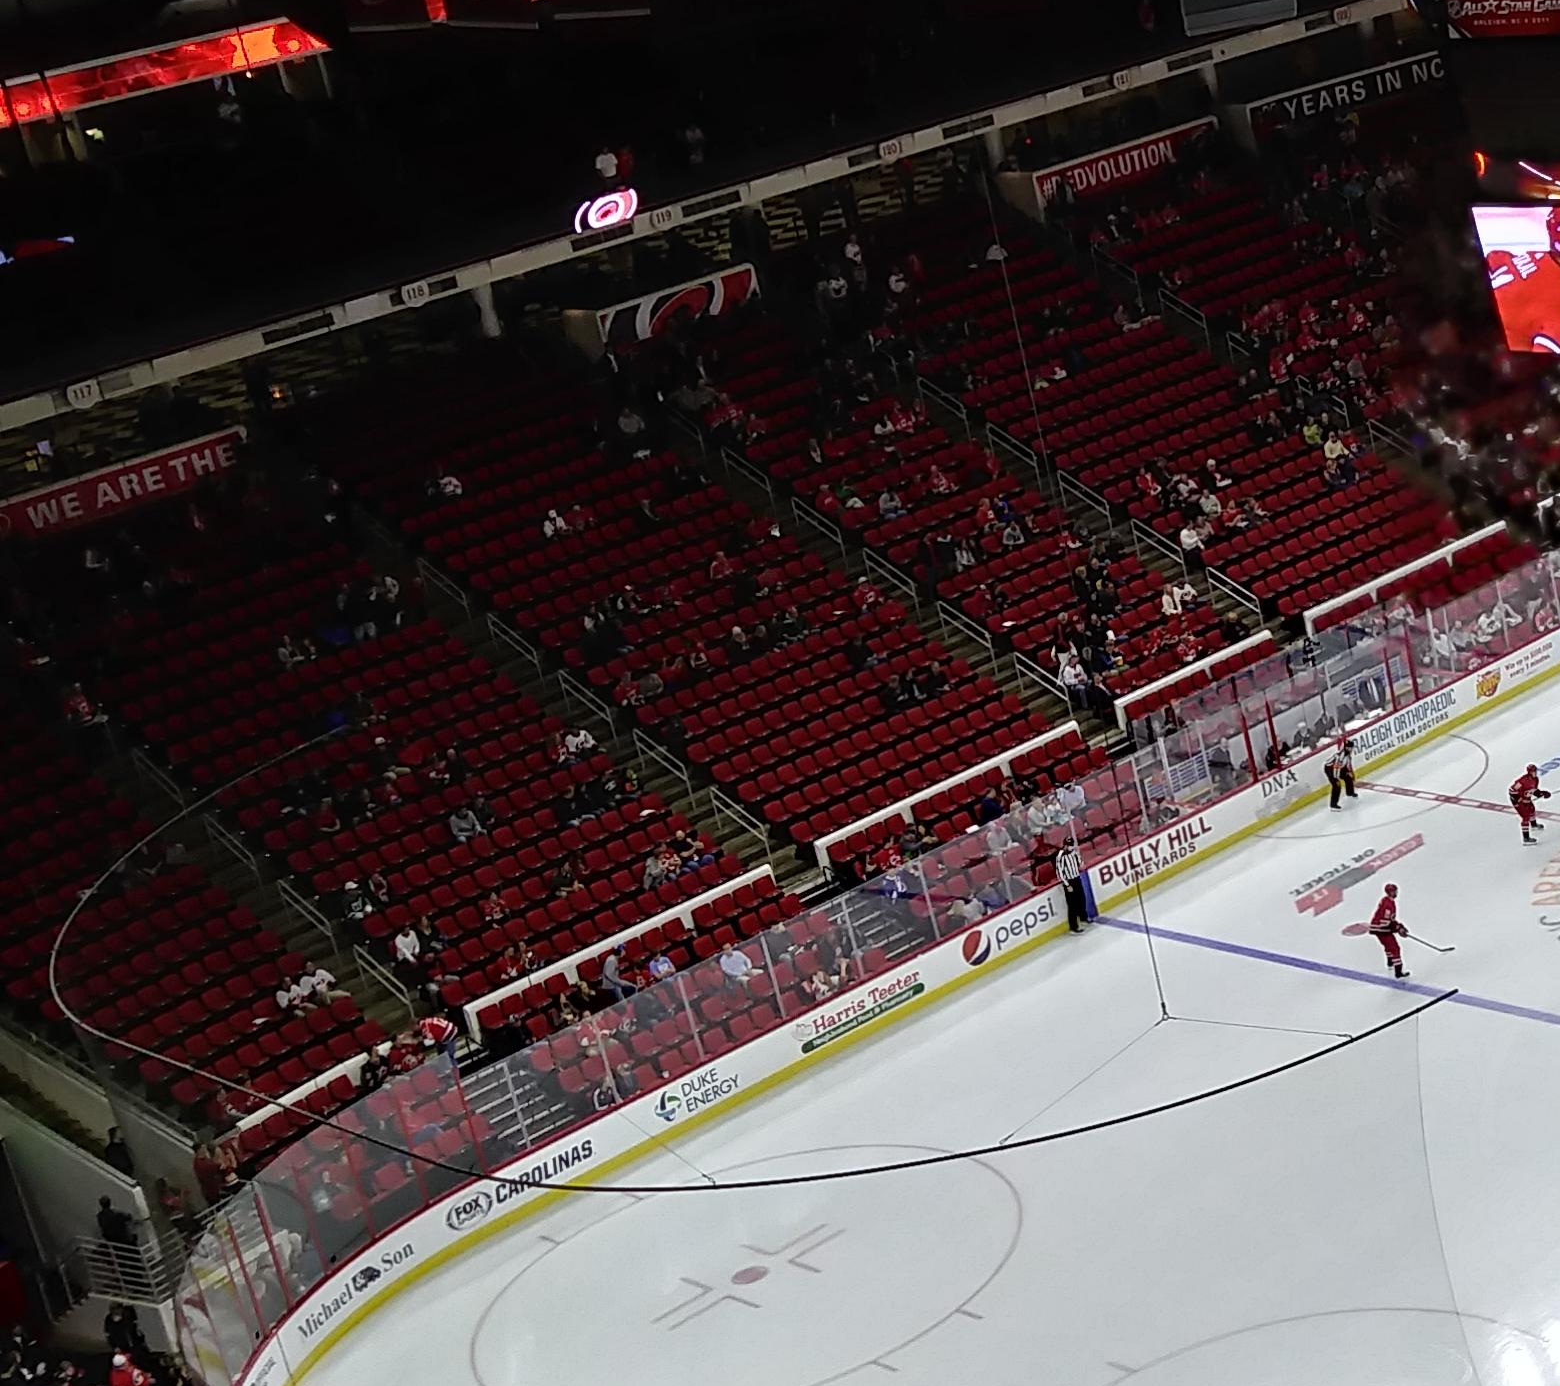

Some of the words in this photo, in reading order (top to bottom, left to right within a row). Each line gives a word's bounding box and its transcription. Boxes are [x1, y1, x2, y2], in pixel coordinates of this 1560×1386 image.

[1283, 79, 1367, 121] YEARS
[1375, 69, 1403, 95] IN
[1412, 57, 1445, 85] NC
[26, 492, 84, 530] WE
[96, 465, 167, 508] ARE
[168, 442, 237, 483] THE
[1352, 721, 1392, 755] RALEIGH
[1393, 688, 1457, 735] ORTHOPAEDIC
[1364, 742, 1395, 761] OFFICIAL
[1396, 729, 1417, 745] TEAM
[1417, 711, 1449, 734] DOCTORS
[1261, 770, 1298, 799] DNA
[1098, 839, 1161, 886] BULLY
[1168, 816, 1212, 850] HILL
[1122, 842, 1197, 887] VINEYARDS
[1352, 848, 1376, 864] OR
[995, 897, 1055, 951] pepsi
[813, 1000, 866, 1035] Harris
[868, 970, 921, 1005] Teeter
[680, 1067, 719, 1097] DUKE
[686, 1074, 740, 1113] ENERGY
[495, 1139, 594, 1204] CAROLINAS
[454, 1192, 484, 1217] FOX
[297, 1283, 354, 1339] Michael
[381, 1242, 415, 1273] Son
